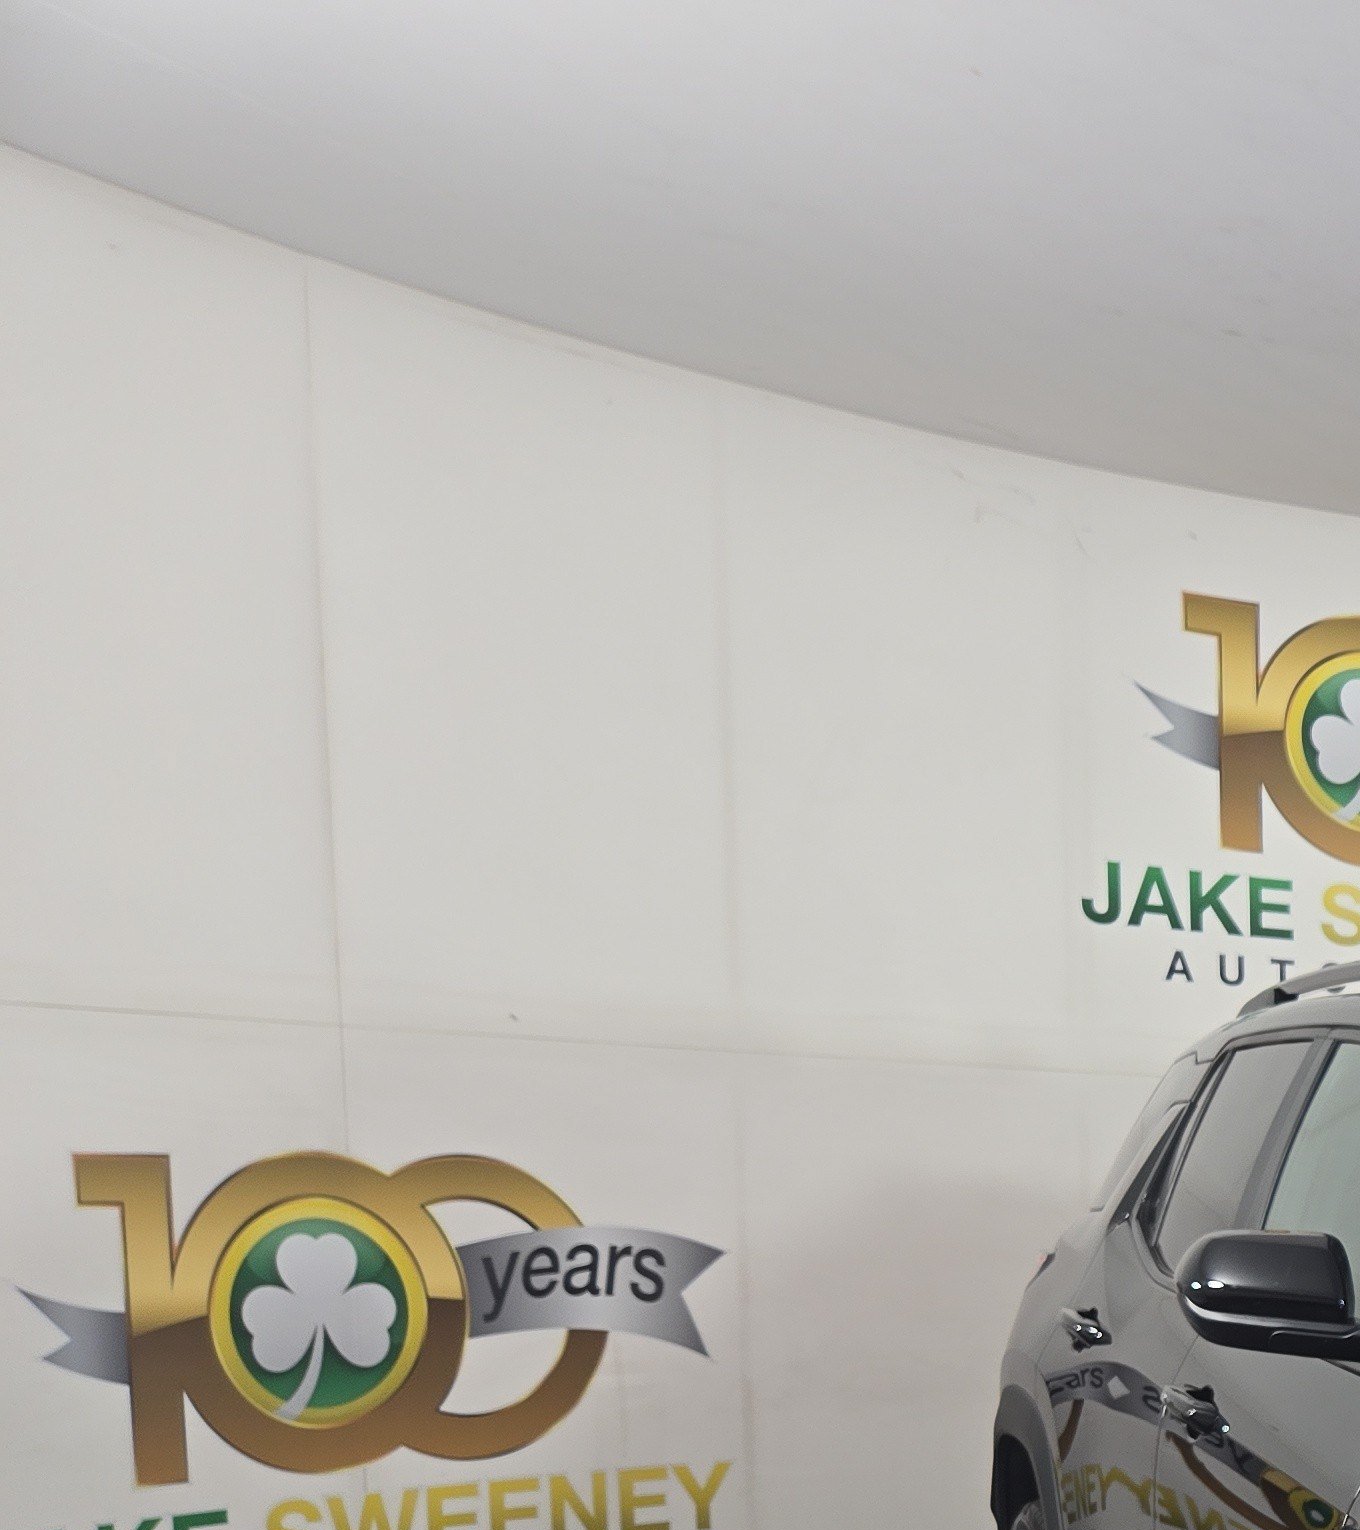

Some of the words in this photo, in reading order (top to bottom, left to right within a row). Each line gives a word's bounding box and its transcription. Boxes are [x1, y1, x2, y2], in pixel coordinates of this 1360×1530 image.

[1082, 861, 1295, 941] JAKE
[72, 1151, 609, 1488] 100
[481, 1243, 667, 1322] years
